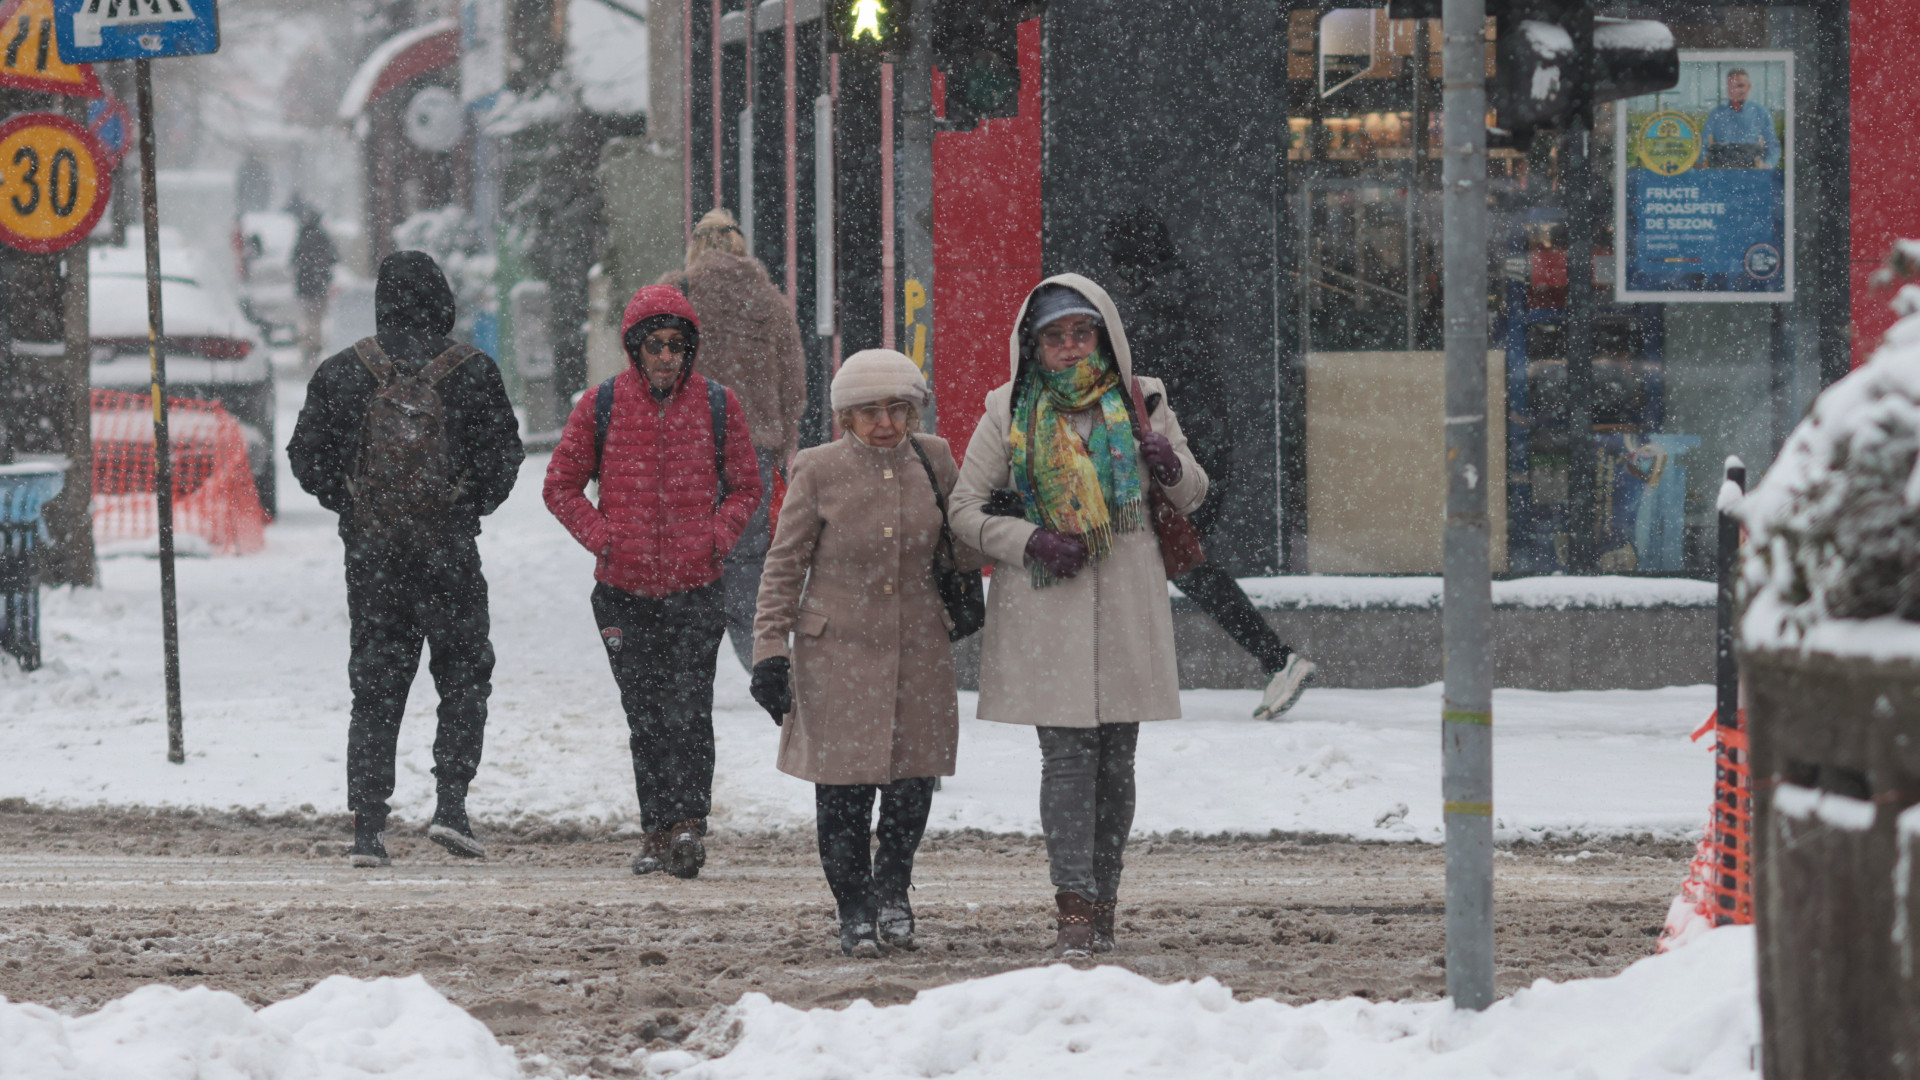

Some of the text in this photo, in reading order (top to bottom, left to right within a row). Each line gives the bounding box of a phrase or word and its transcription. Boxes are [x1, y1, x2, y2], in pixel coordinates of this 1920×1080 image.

[11, 146, 79, 217] 30
[1646, 187, 1700, 199] FRUCTE
[1645, 203, 1726, 215] PROASPETE
[1645, 218, 1717, 230] DE SEZON.
